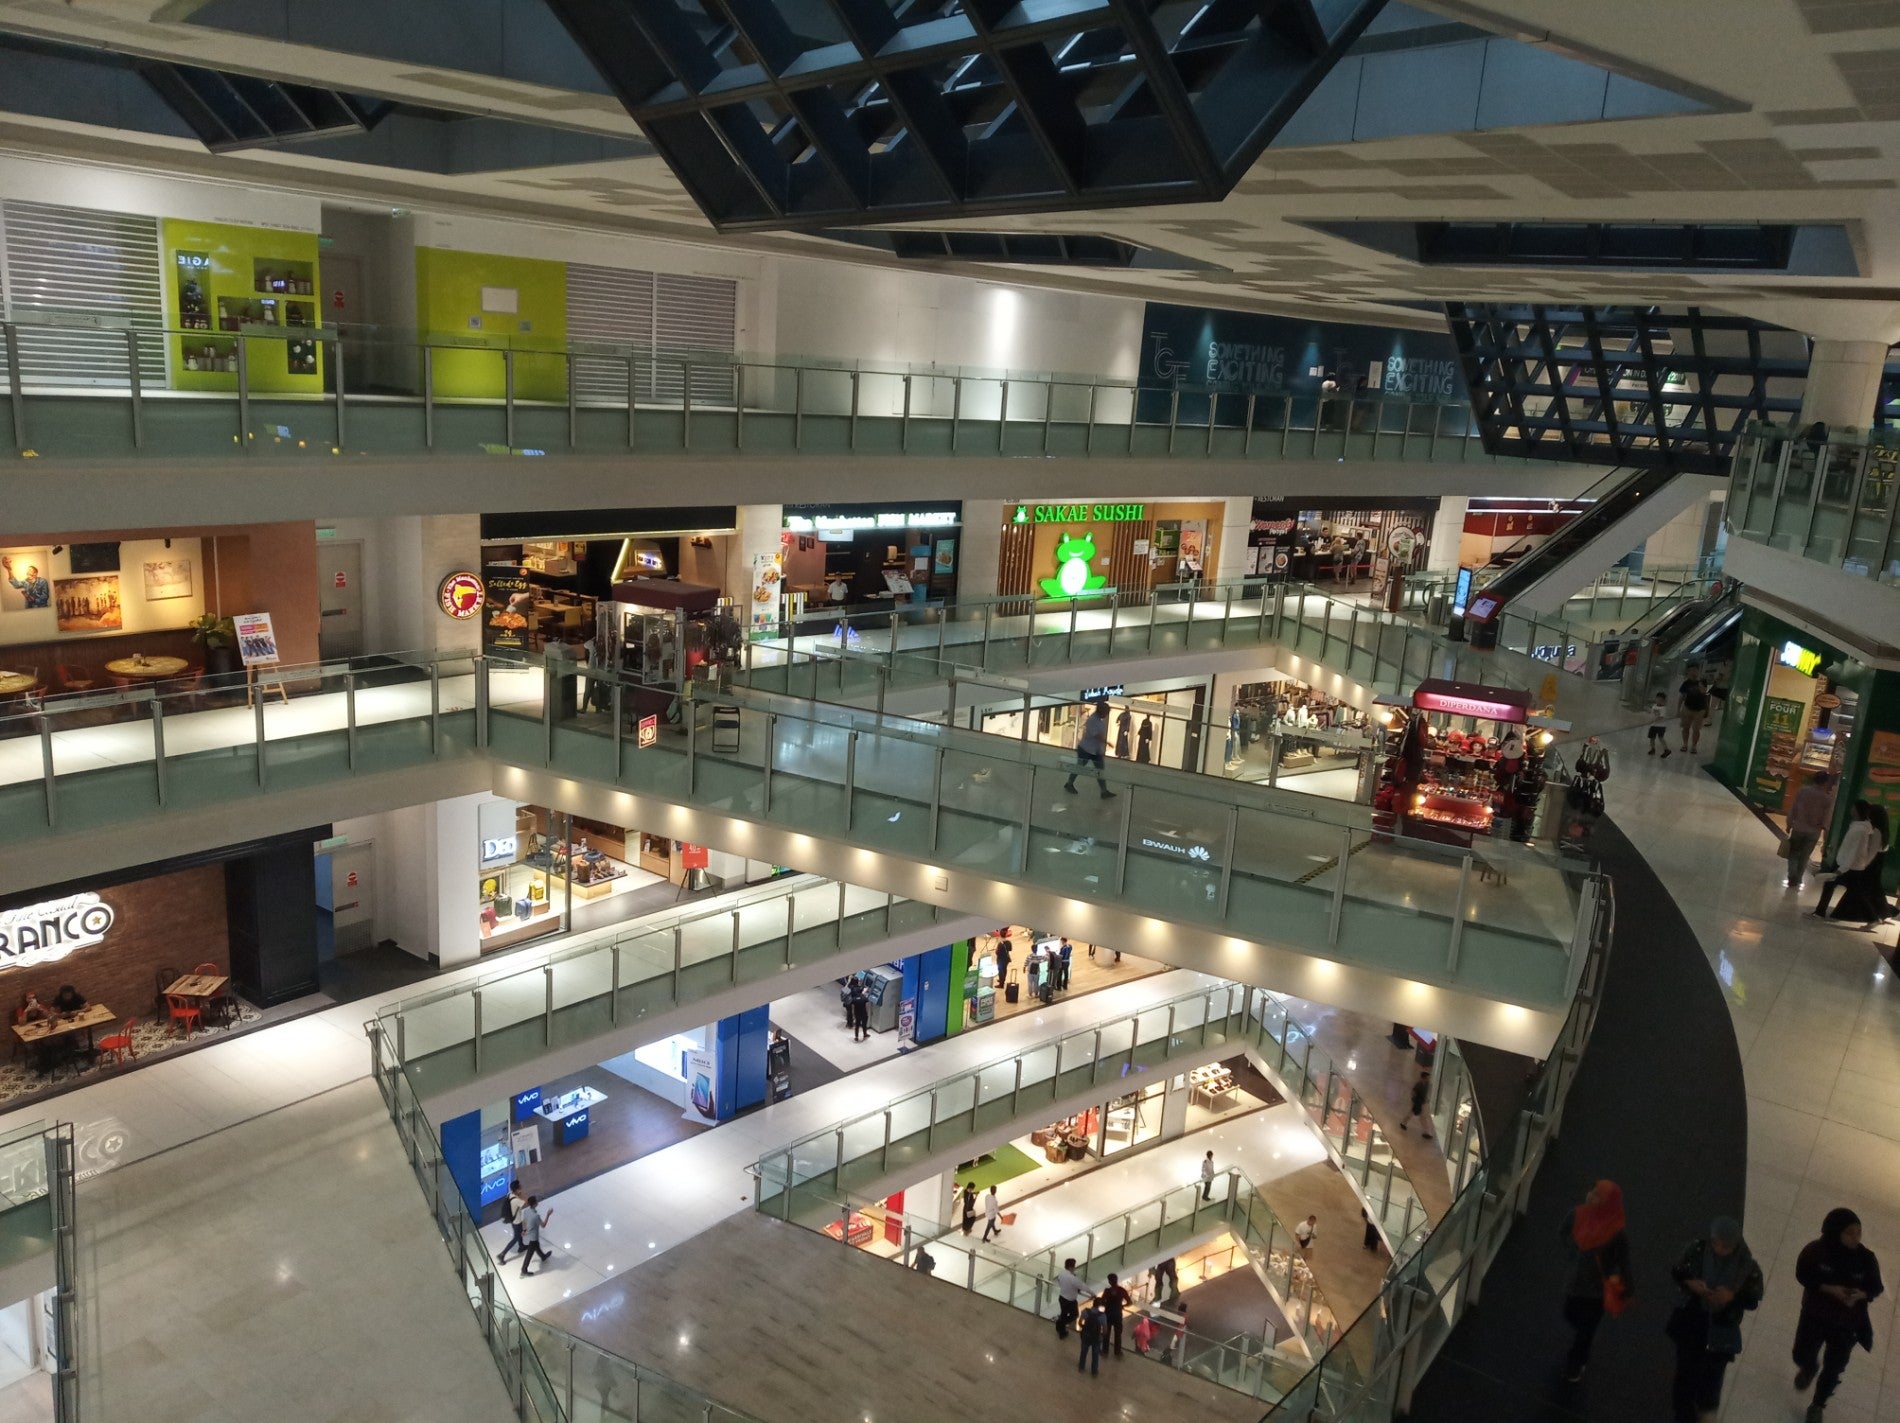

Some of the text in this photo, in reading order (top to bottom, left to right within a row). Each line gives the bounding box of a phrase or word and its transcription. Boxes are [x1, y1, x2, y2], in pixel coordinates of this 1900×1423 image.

[1208, 341, 1285, 362] SOMETHING
[1206, 359, 1284, 383] EXCITING
[1387, 356, 1455, 376] SOMETHING
[1384, 372, 1453, 395] EXCITING
[1034, 504, 1144, 522] SAKAE SUSHI
[1440, 699, 1498, 715] DIPERDANA
[1770, 704, 1796, 714] FOUR
